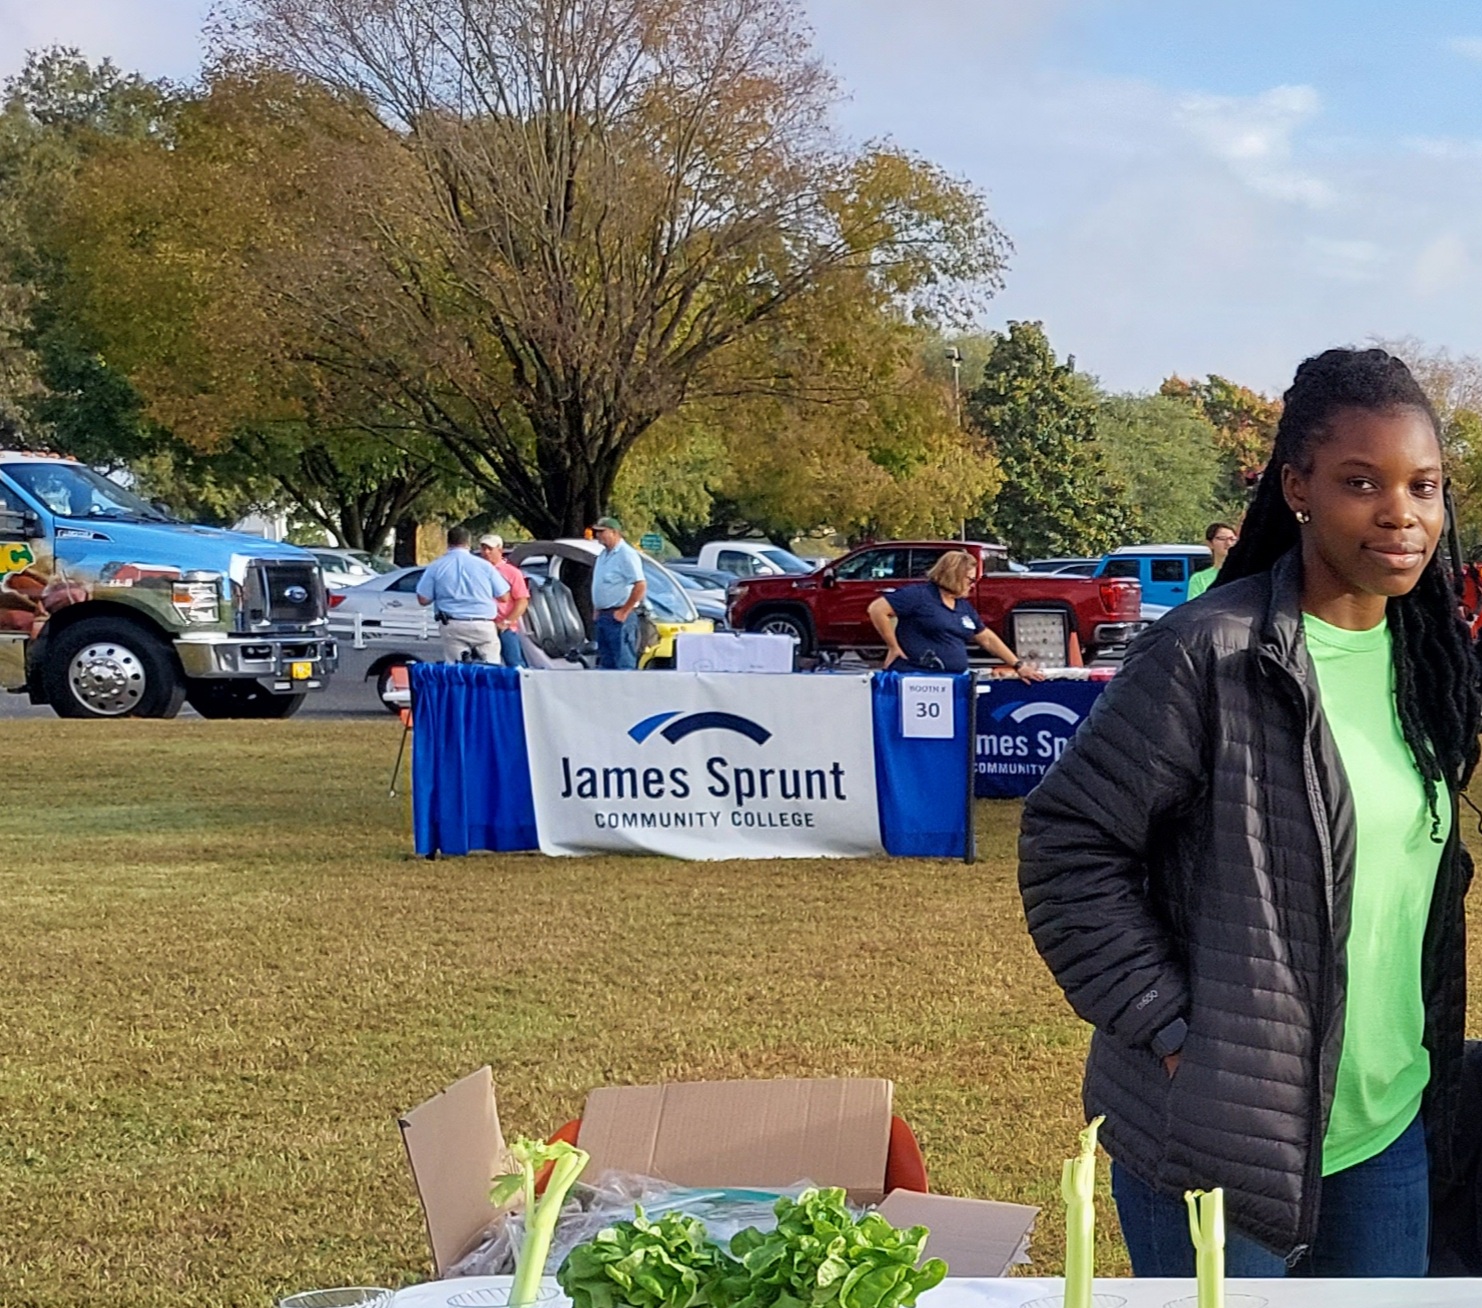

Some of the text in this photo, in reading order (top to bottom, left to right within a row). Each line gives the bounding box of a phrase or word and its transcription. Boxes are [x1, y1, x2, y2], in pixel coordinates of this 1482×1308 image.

[916, 702, 940, 718] 30
[976, 733, 1029, 756] mes
[561, 756, 847, 806] James Sprunt
[595, 810, 815, 829] COMMUNITY COLLEGE
